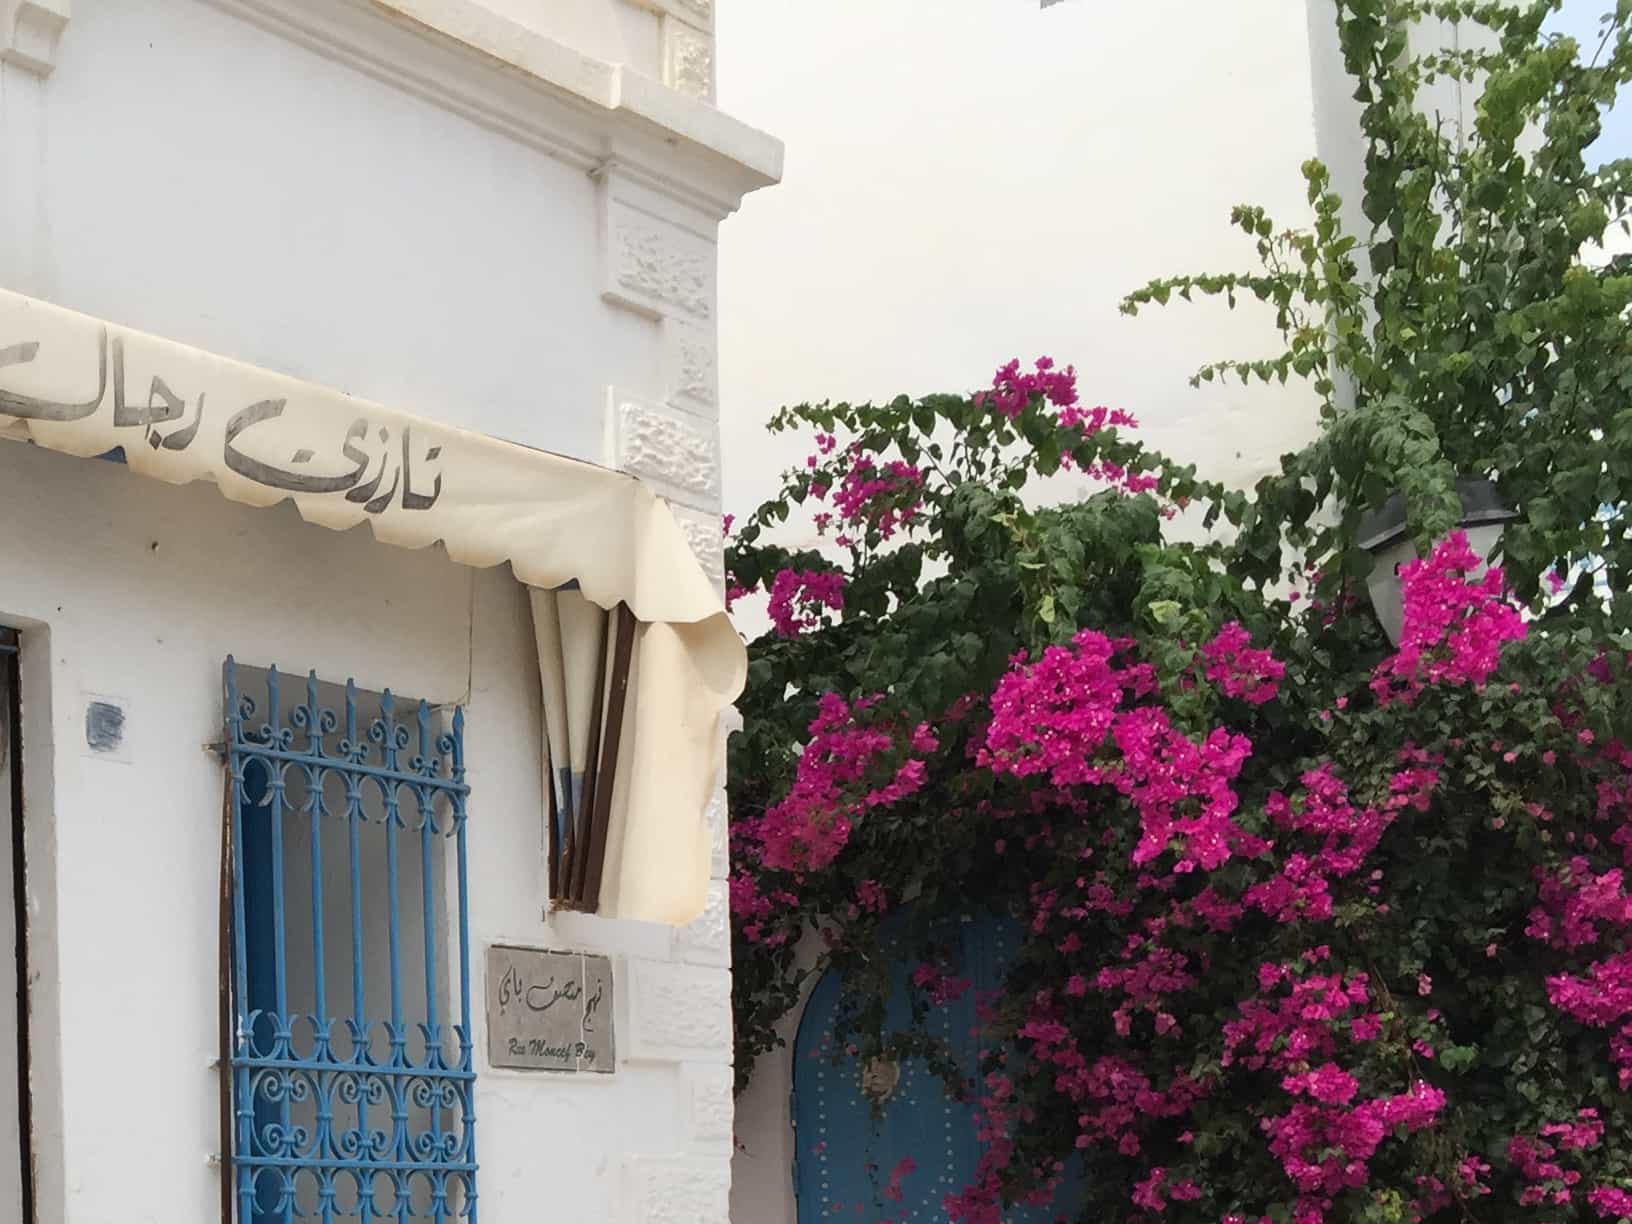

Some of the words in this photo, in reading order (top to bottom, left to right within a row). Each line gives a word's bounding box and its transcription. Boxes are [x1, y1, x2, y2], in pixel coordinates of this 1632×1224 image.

[498, 965, 523, 1016] باي
[526, 975, 582, 1011] منصف
[583, 978, 602, 1033] نهج
[508, 1037, 526, 1056] Rue
[528, 1038, 571, 1062] Moncef
[575, 1042, 595, 1064] Bey
